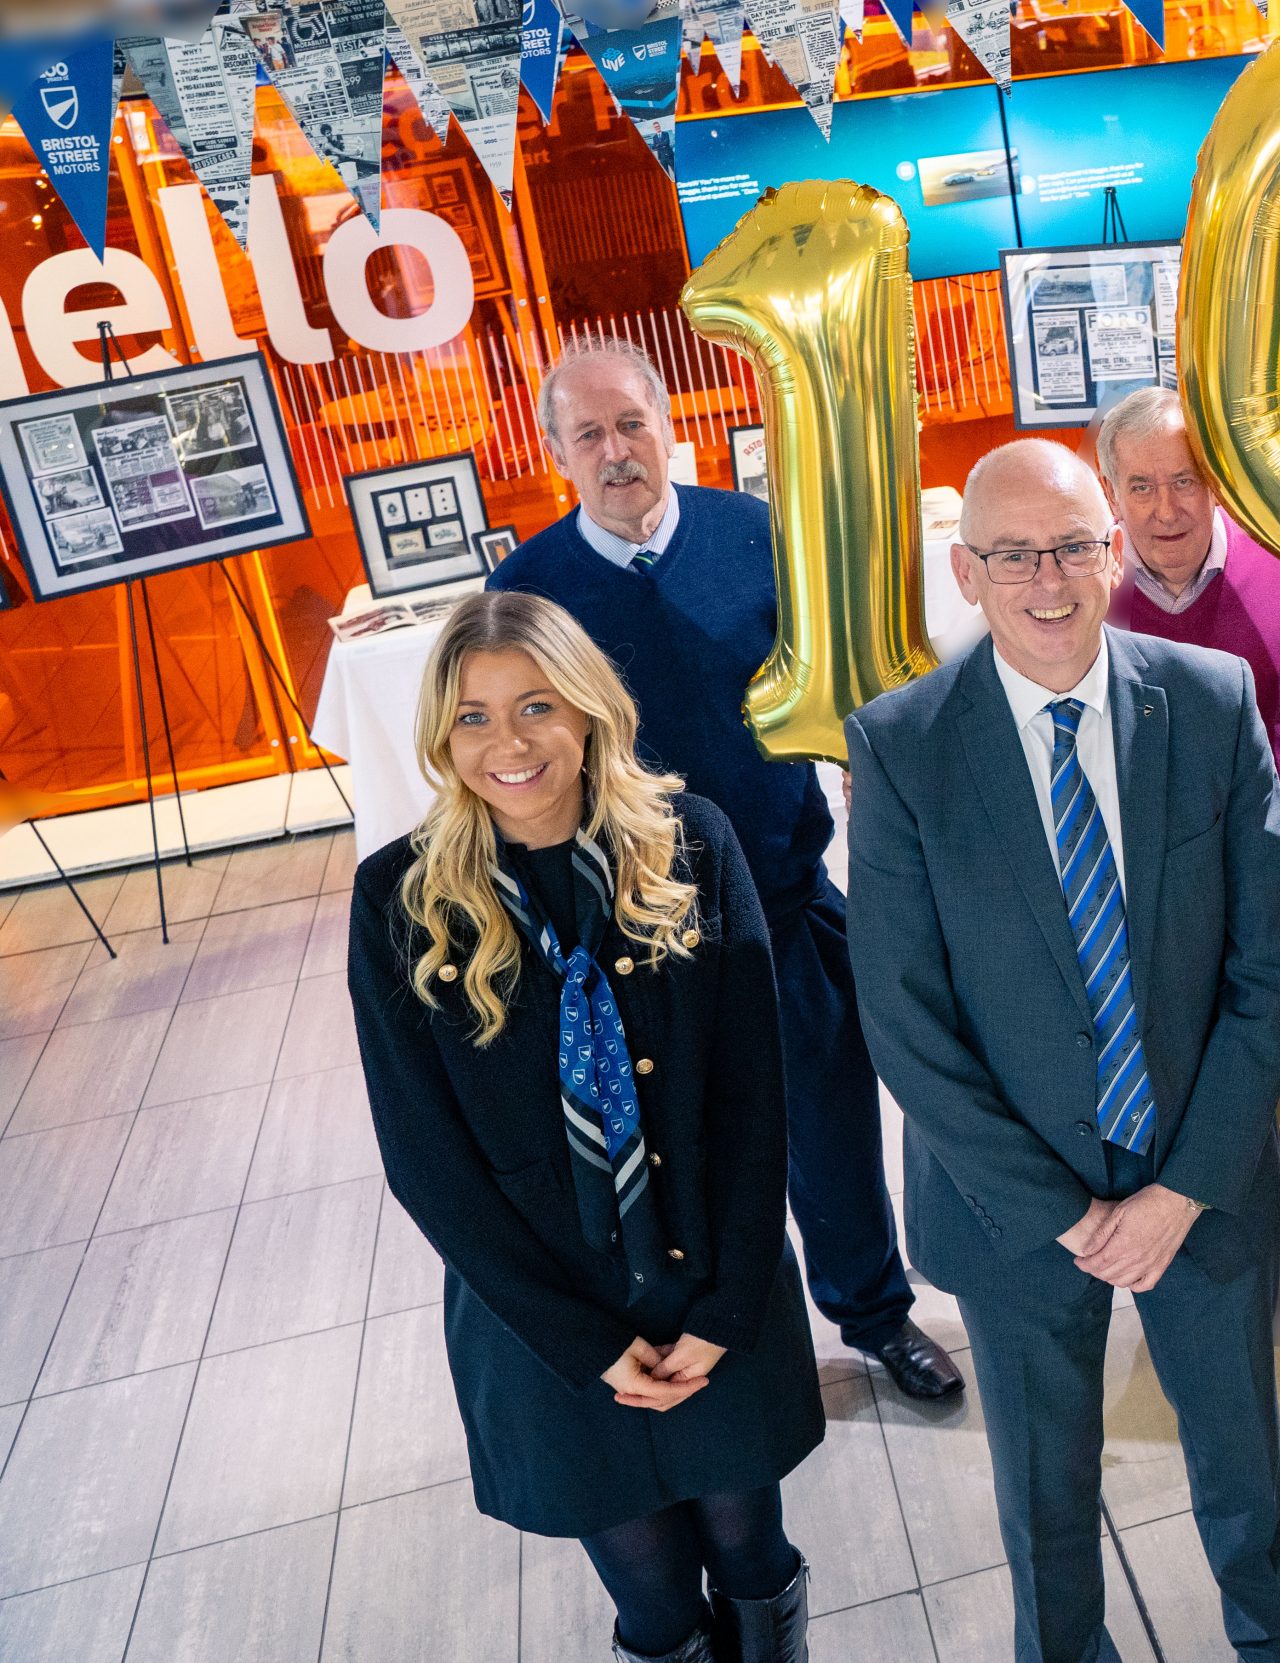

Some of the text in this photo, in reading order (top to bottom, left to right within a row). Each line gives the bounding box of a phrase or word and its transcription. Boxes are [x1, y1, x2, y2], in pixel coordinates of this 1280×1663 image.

[365, 9, 384, 18] FORD
[765, 8, 777, 16] AND
[779, 4, 797, 13] NIGHT
[761, 25, 796, 40] STREET MOT
[334, 41, 364, 52] FIESTA
[523, 37, 551, 50] REET
[647, 41, 668, 49] BRISTOL
[521, 48, 551, 59] OTORS
[224, 60, 250, 68] DISCOUNT
[601, 53, 626, 72] LIVE
[367, 90, 383, 99] Stree
[41, 135, 101, 152] BRISTOL
[47, 148, 99, 165] STREET
[203, 156, 218, 168] USED
[218, 150, 236, 162] CARS
[53, 161, 101, 176] MOTORS
[0, 172, 475, 397] ello
[1087, 310, 1148, 329] FORD
